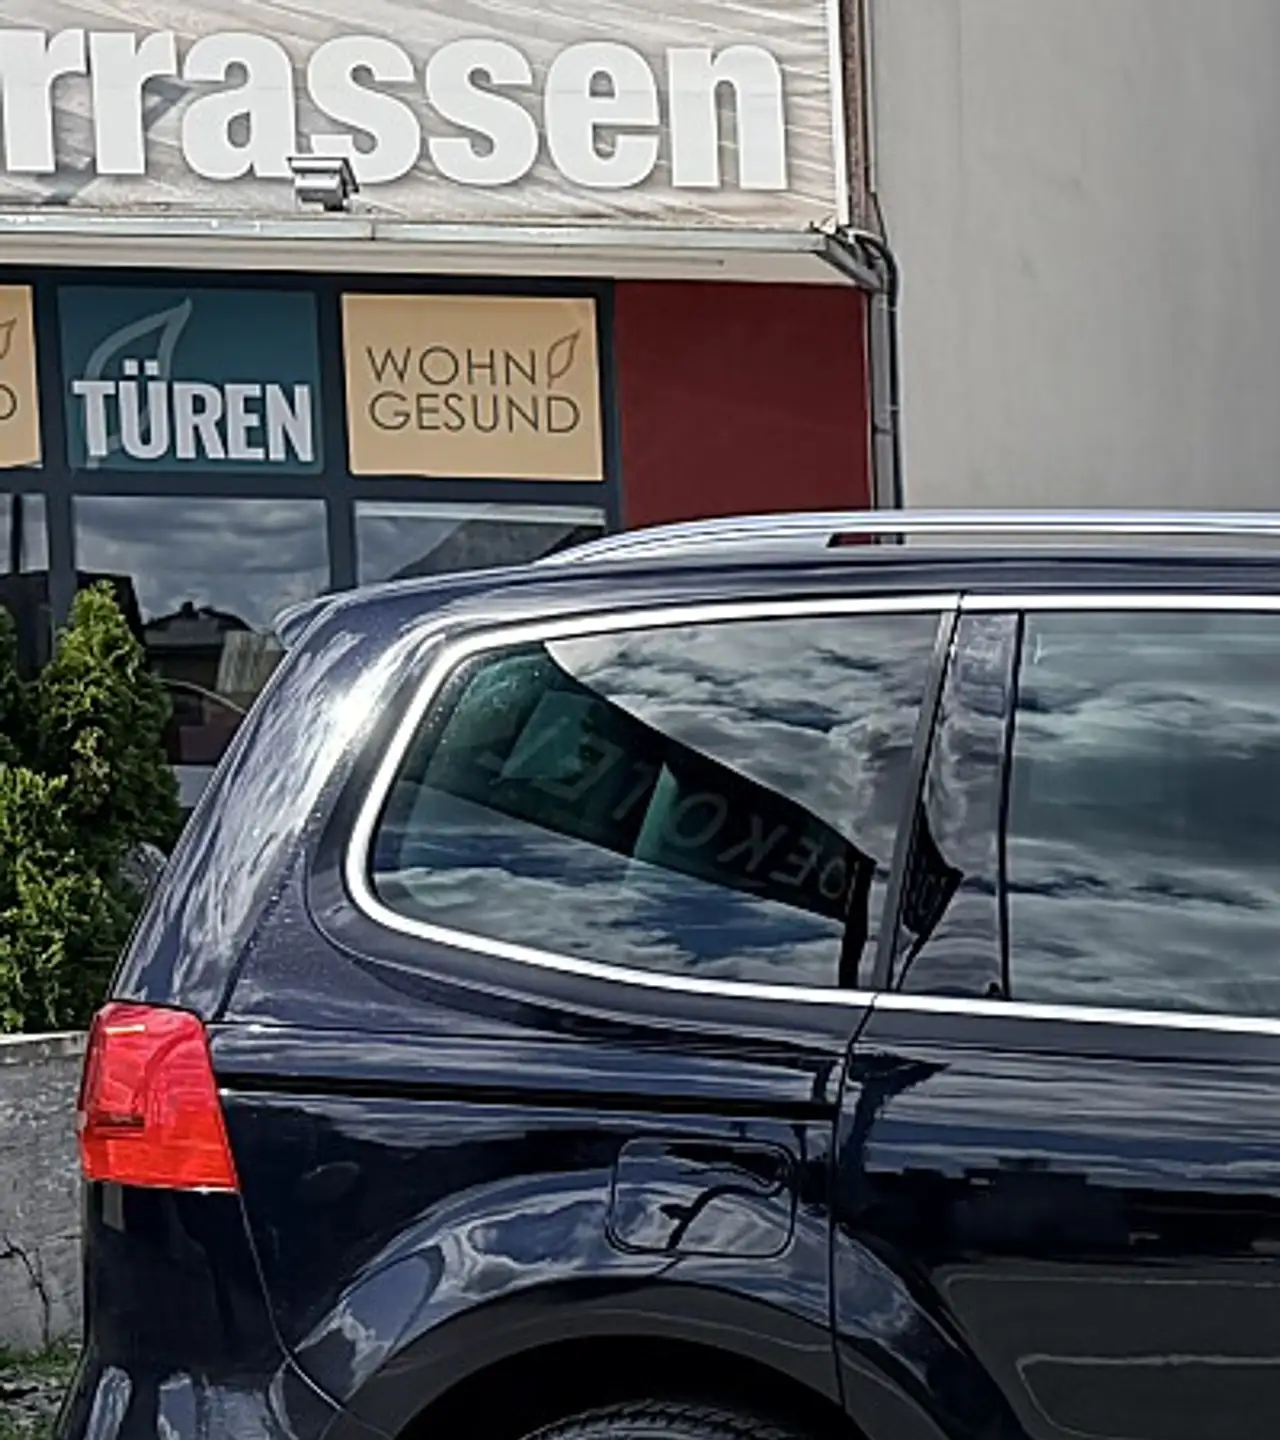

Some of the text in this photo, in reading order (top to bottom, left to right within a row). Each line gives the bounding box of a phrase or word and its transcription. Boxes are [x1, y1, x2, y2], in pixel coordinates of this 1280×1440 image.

[0, 28, 789, 191] rrassen
[366, 345, 537, 387] WOHN
[72, 358, 313, 463] TÜREN
[368, 389, 581, 434] GESUND
